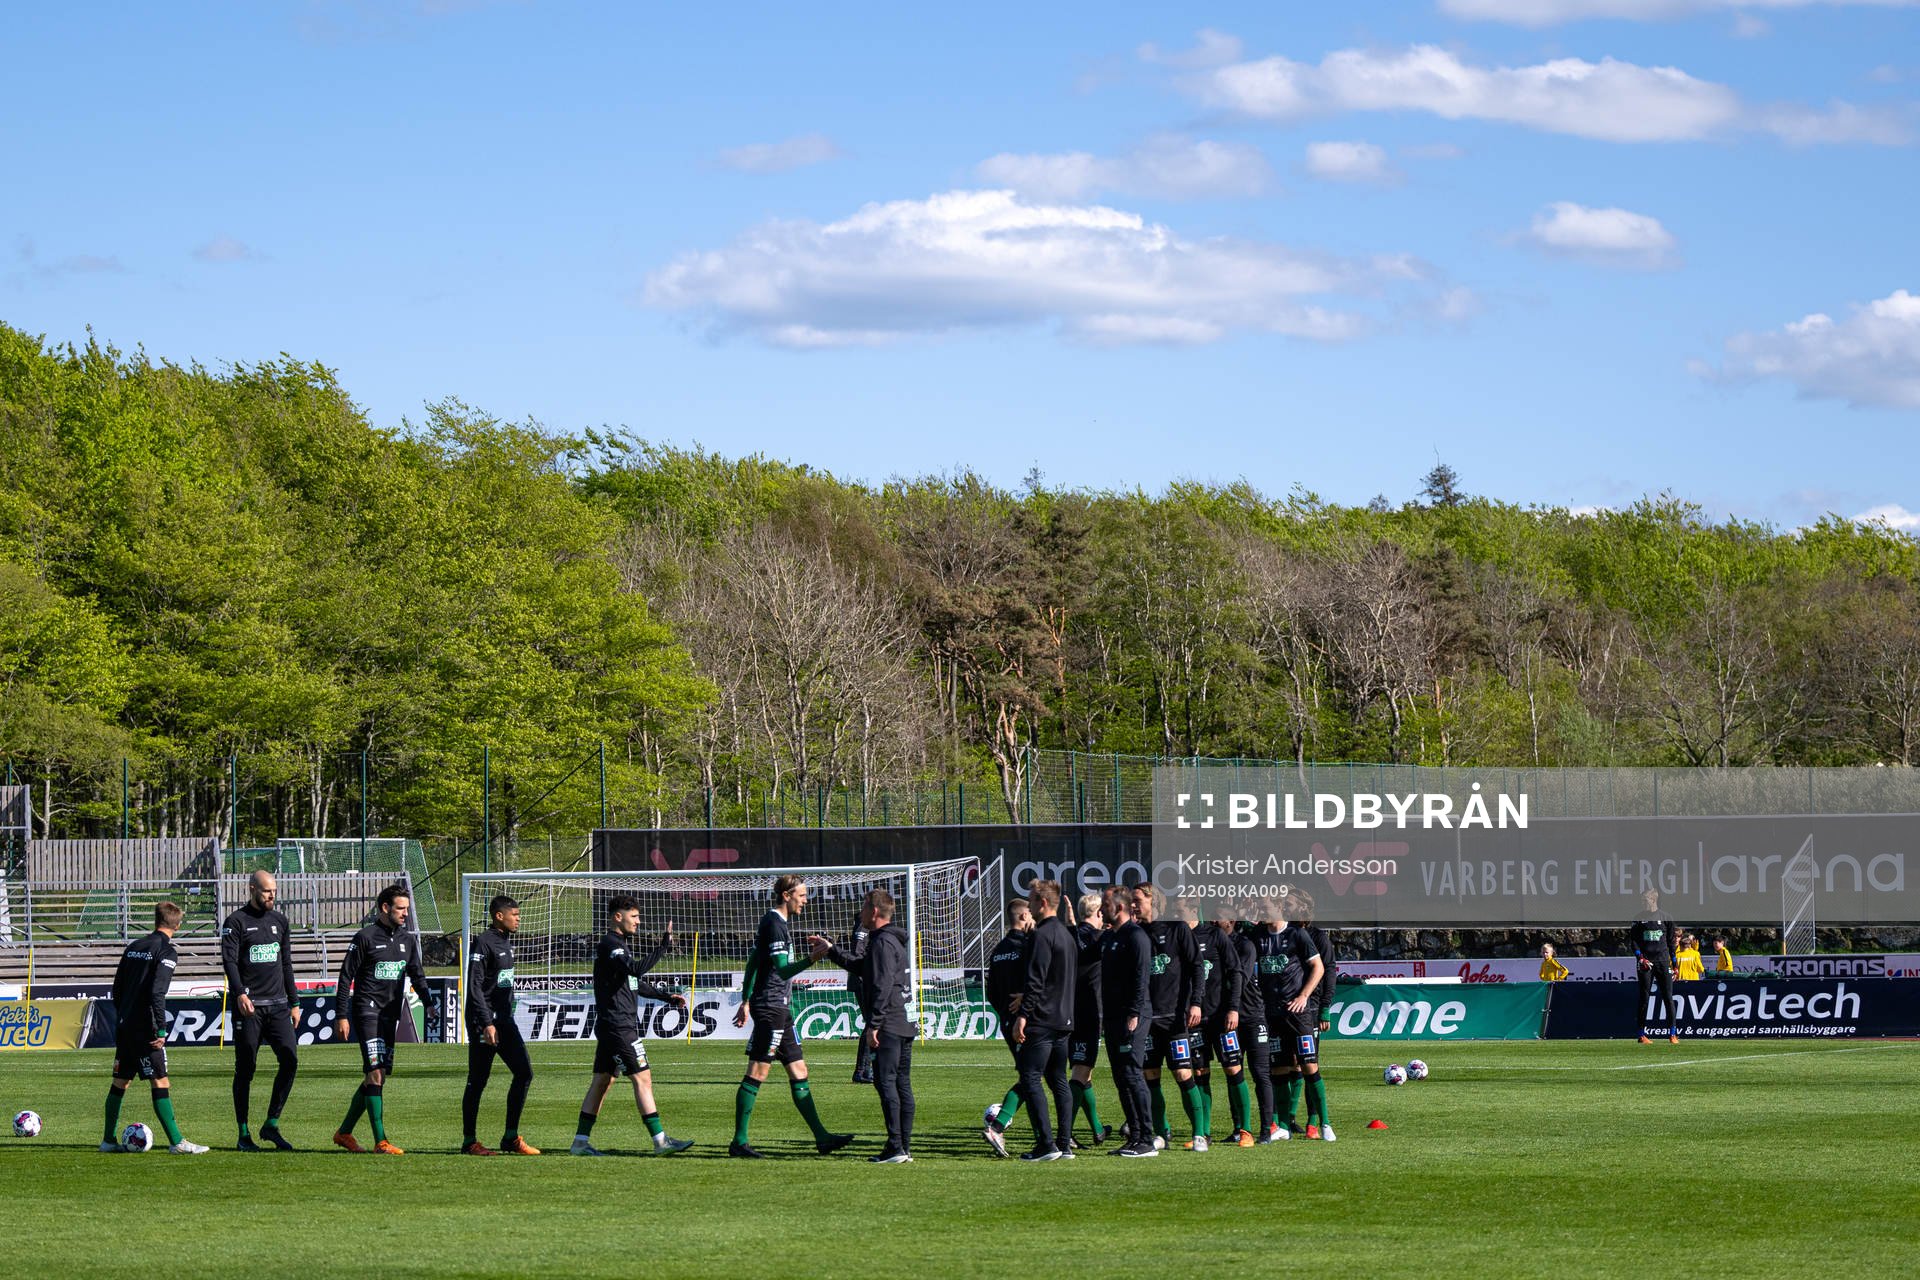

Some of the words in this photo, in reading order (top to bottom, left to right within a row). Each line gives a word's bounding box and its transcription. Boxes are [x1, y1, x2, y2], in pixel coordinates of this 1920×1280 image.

[1420, 859, 1559, 897] VARBERG
[1575, 858, 1688, 895] ENERGI
[1711, 853, 1904, 893] arena
[1769, 959, 1885, 978] KRONANS
[527, 1001, 721, 1039] TENOS
[1646, 982, 1861, 1021] inviatech
[1643, 1026, 1683, 1035] kreav
[1685, 1026, 1693, 1034] &
[1696, 1026, 1756, 1037] engagerad
[1758, 1025, 1856, 1036] samhällsbyggare
